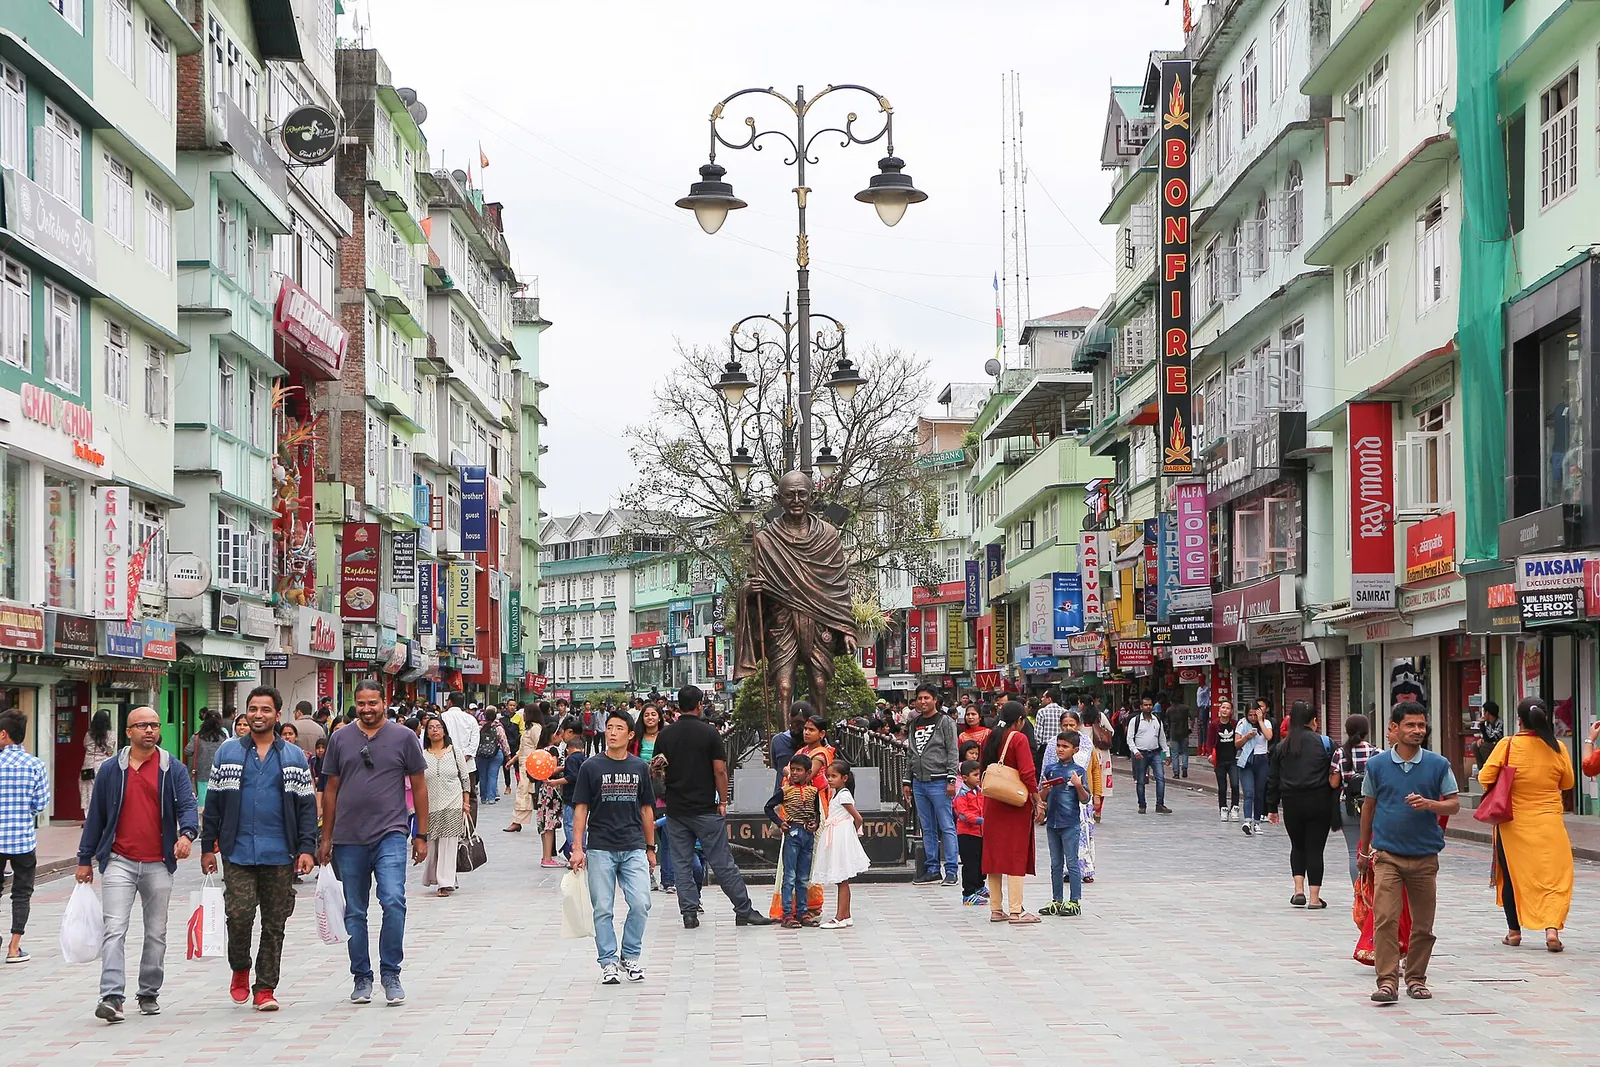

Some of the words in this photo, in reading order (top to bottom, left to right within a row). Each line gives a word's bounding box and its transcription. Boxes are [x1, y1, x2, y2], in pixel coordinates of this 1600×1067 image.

[1164, 138, 1188, 395] BONFIRE
[21, 382, 53, 425] CHAI
[62, 400, 94, 443] CHUN
[1164, 464, 1191, 472] BARESTO
[1181, 486, 1203, 498] ALFA
[104, 489, 118, 543] CHAI
[465, 511, 480, 520] guest
[465, 532, 481, 540] house
[1183, 502, 1206, 580] LODGE
[344, 566, 377, 576] Rajdhani
[1084, 535, 1099, 614] PARIVAR
[104, 556, 117, 611] CHUN
[420, 566, 429, 591] LAXMI
[1526, 579, 1561, 587] EXCLUSIVE
[457, 567, 469, 607] house
[968, 574, 977, 605] DZONG
[1441, 587, 1451, 599] SONS
[1356, 590, 1391, 602] SAMRAT
[1526, 595, 1539, 604] MIN.
[1540, 594, 1554, 603] PASS
[1554, 593, 1574, 602] PHOTO
[420, 594, 429, 624] SWEETS
[1522, 602, 1575, 613] XEROX
[457, 614, 469, 637] roll
[1152, 626, 1171, 634] CHINA
[995, 627, 1005, 664] GOLDEN
[1073, 635, 1098, 644] PARIVAR
[1119, 642, 1151, 650] MONEY
[1174, 647, 1193, 655] CHINA
[1193, 646, 1212, 655] BAZAR
[1028, 659, 1051, 667] vivo
[602, 773, 612, 784] MY
[614, 773, 631, 784] ROAD
[632, 773, 640, 784] TO
[739, 824, 755, 840] G.
